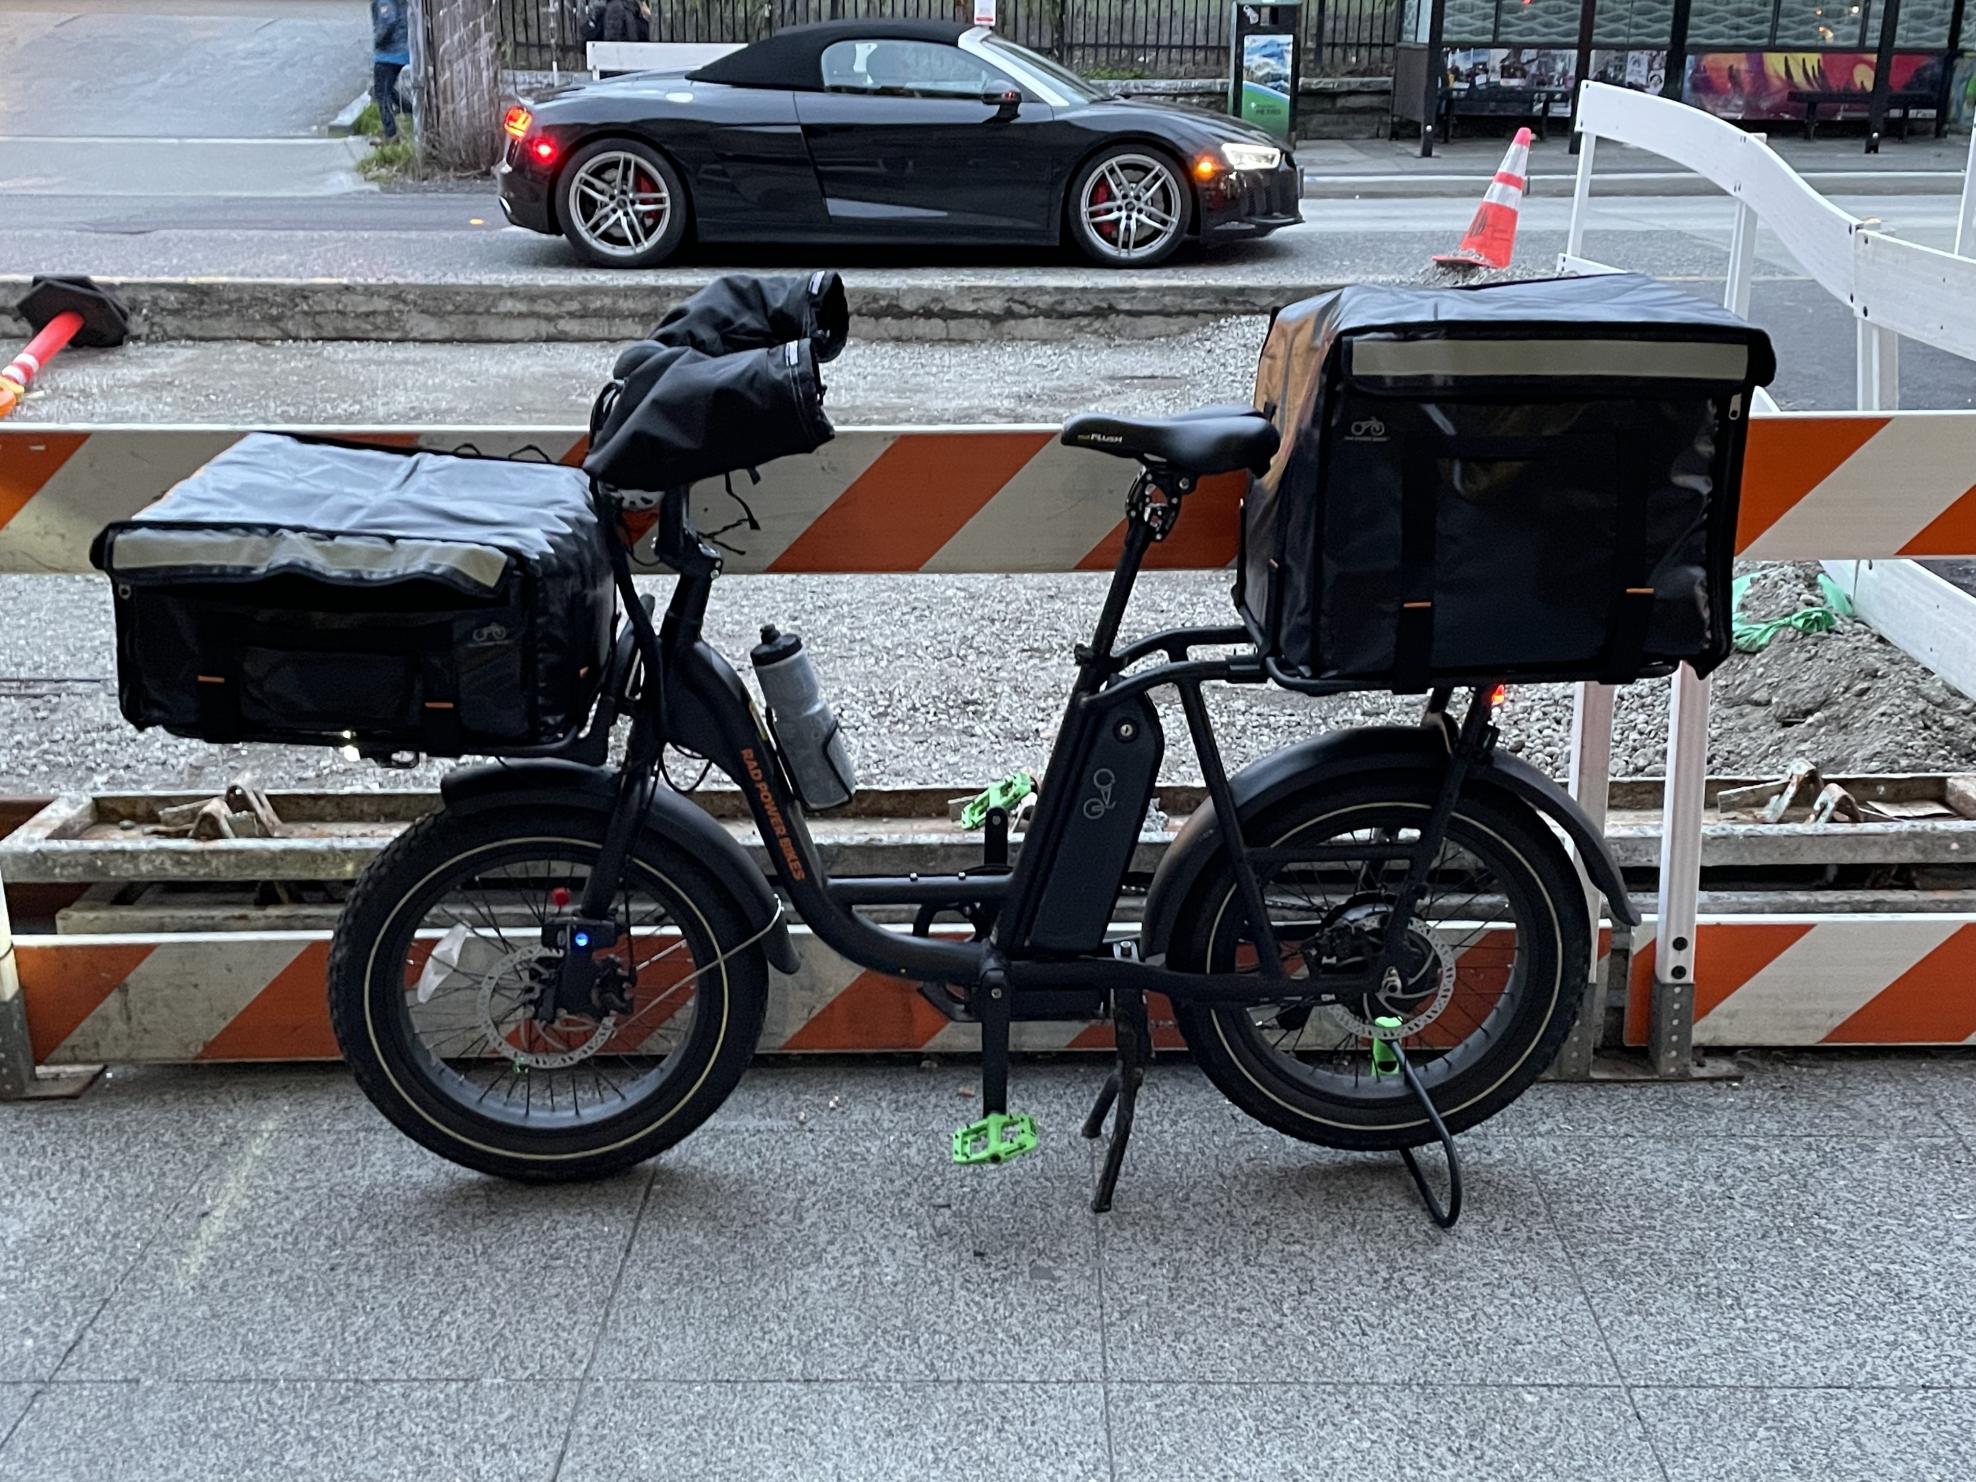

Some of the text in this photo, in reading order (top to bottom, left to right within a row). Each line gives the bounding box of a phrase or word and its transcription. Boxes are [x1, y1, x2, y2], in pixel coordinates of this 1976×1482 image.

[740, 748, 806, 881] RAD POWER BIKES
